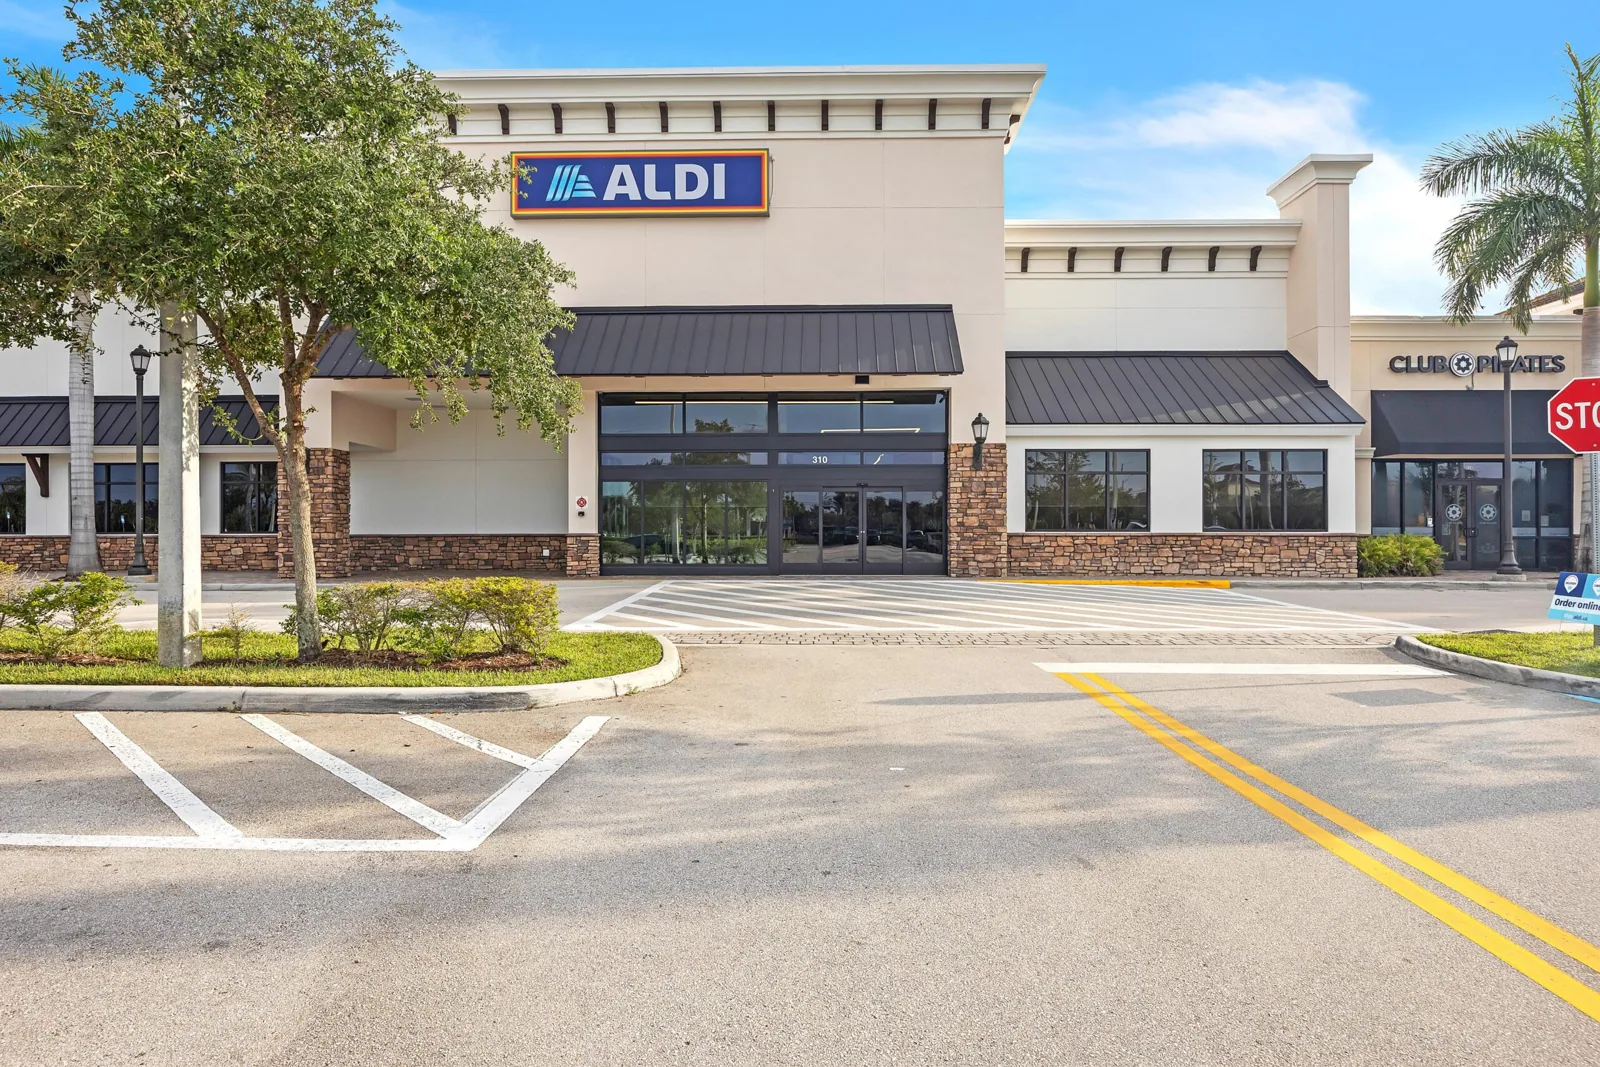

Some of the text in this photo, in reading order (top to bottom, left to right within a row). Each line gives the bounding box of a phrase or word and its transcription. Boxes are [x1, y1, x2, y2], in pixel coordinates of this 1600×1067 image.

[602, 163, 726, 201] ALDI
[1389, 355, 1447, 374] CLUB
[812, 455, 828, 464] 310
[1554, 598, 1577, 608] Order
